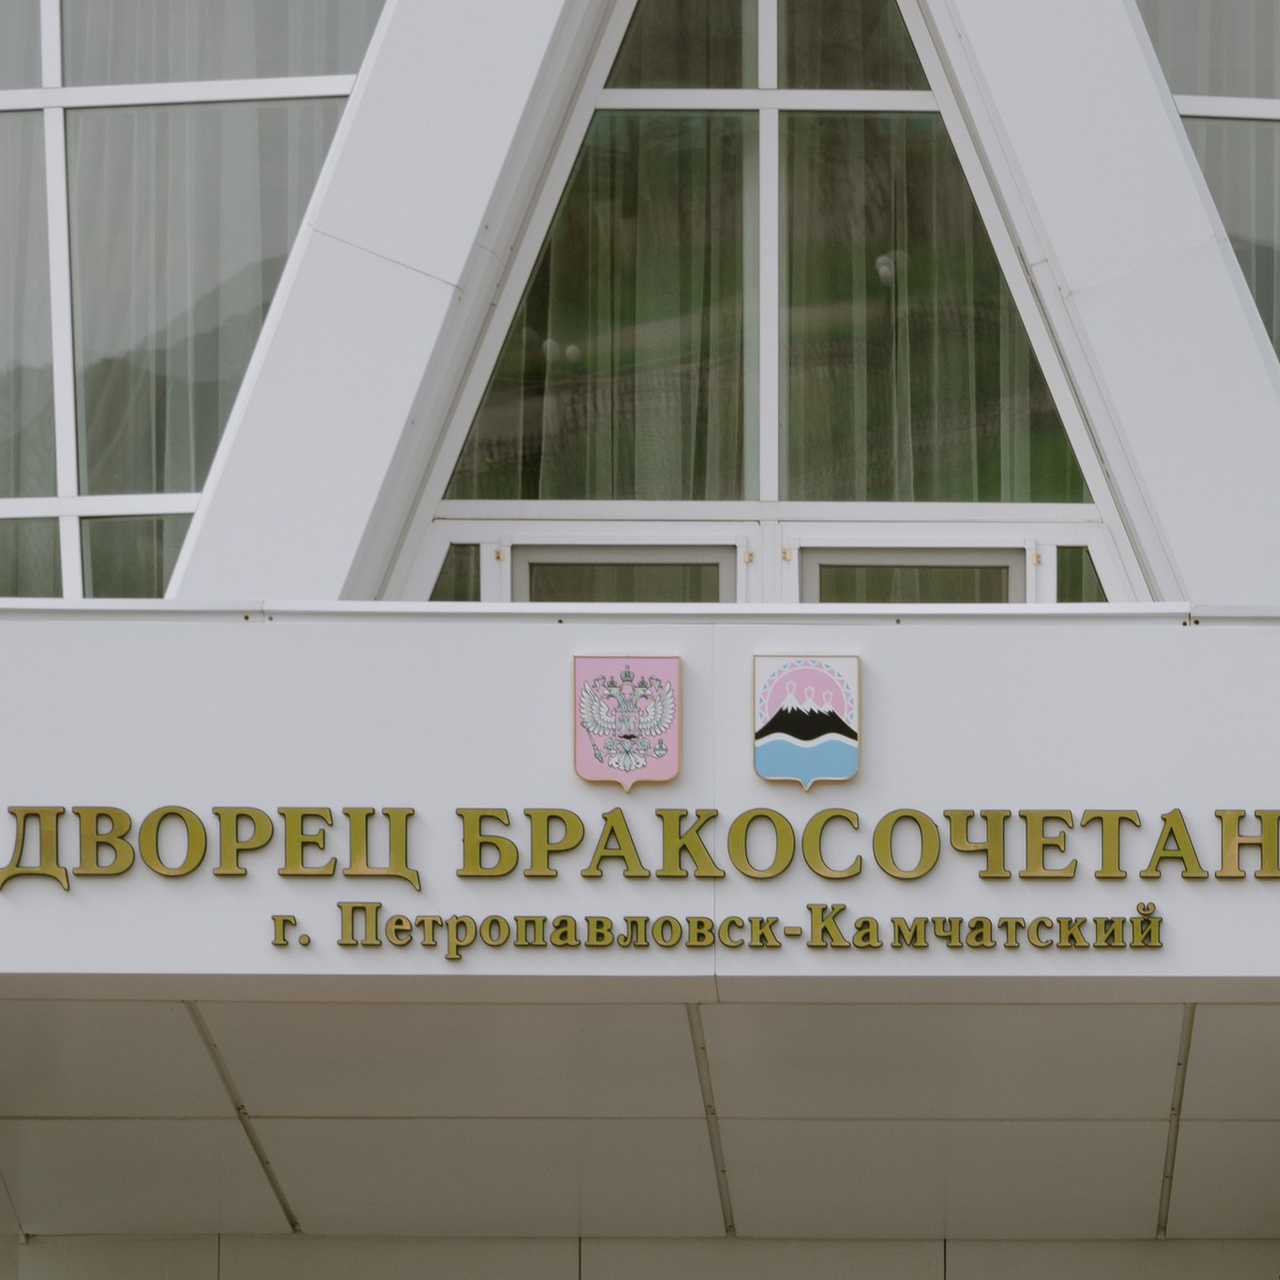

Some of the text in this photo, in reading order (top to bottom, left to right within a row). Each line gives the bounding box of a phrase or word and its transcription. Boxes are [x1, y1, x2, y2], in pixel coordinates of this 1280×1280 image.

[0, 806, 421, 891] ДВОРЕЦ
[271, 902, 1164, 960] г. Петропавловск-Камчатский
